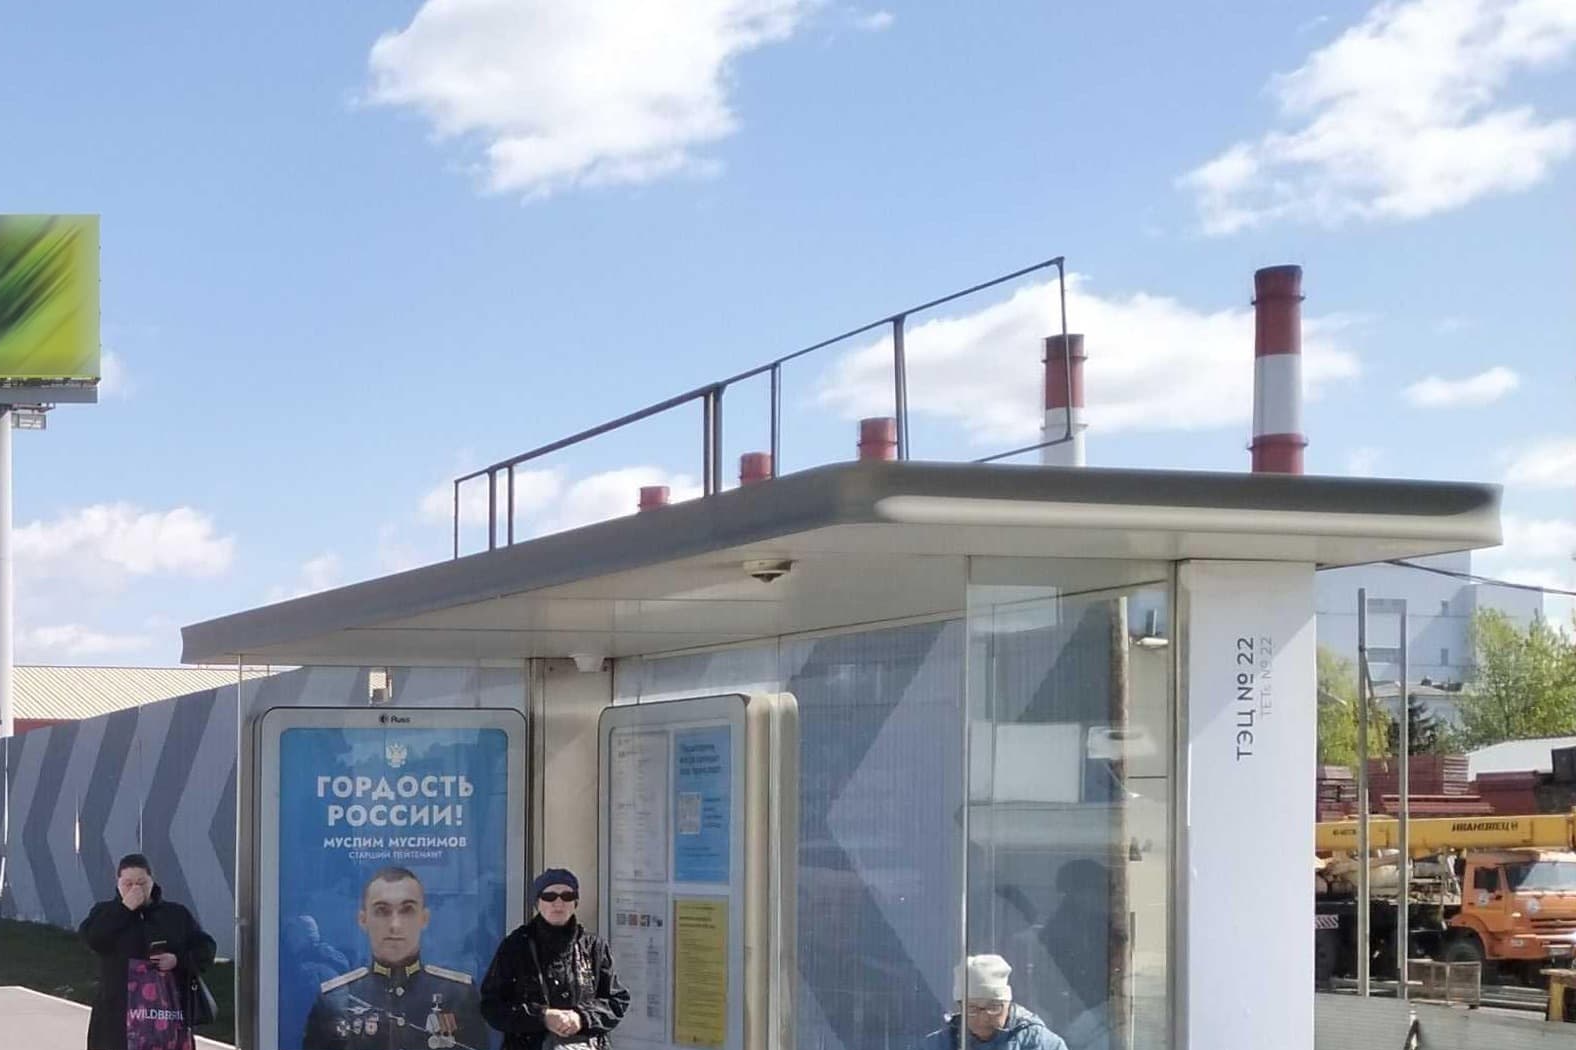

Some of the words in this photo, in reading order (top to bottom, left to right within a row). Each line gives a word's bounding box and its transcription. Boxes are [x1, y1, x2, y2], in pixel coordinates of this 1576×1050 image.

[1236, 637, 1254, 665] 22
[1236, 709, 1256, 761] ТЭЦ
[317, 775, 474, 801] ГОРДОСТЬ
[328, 804, 464, 827] РОССИИ!
[324, 836, 384, 848] МУСЛИМ
[388, 836, 467, 848] МУСЛИМОВ
